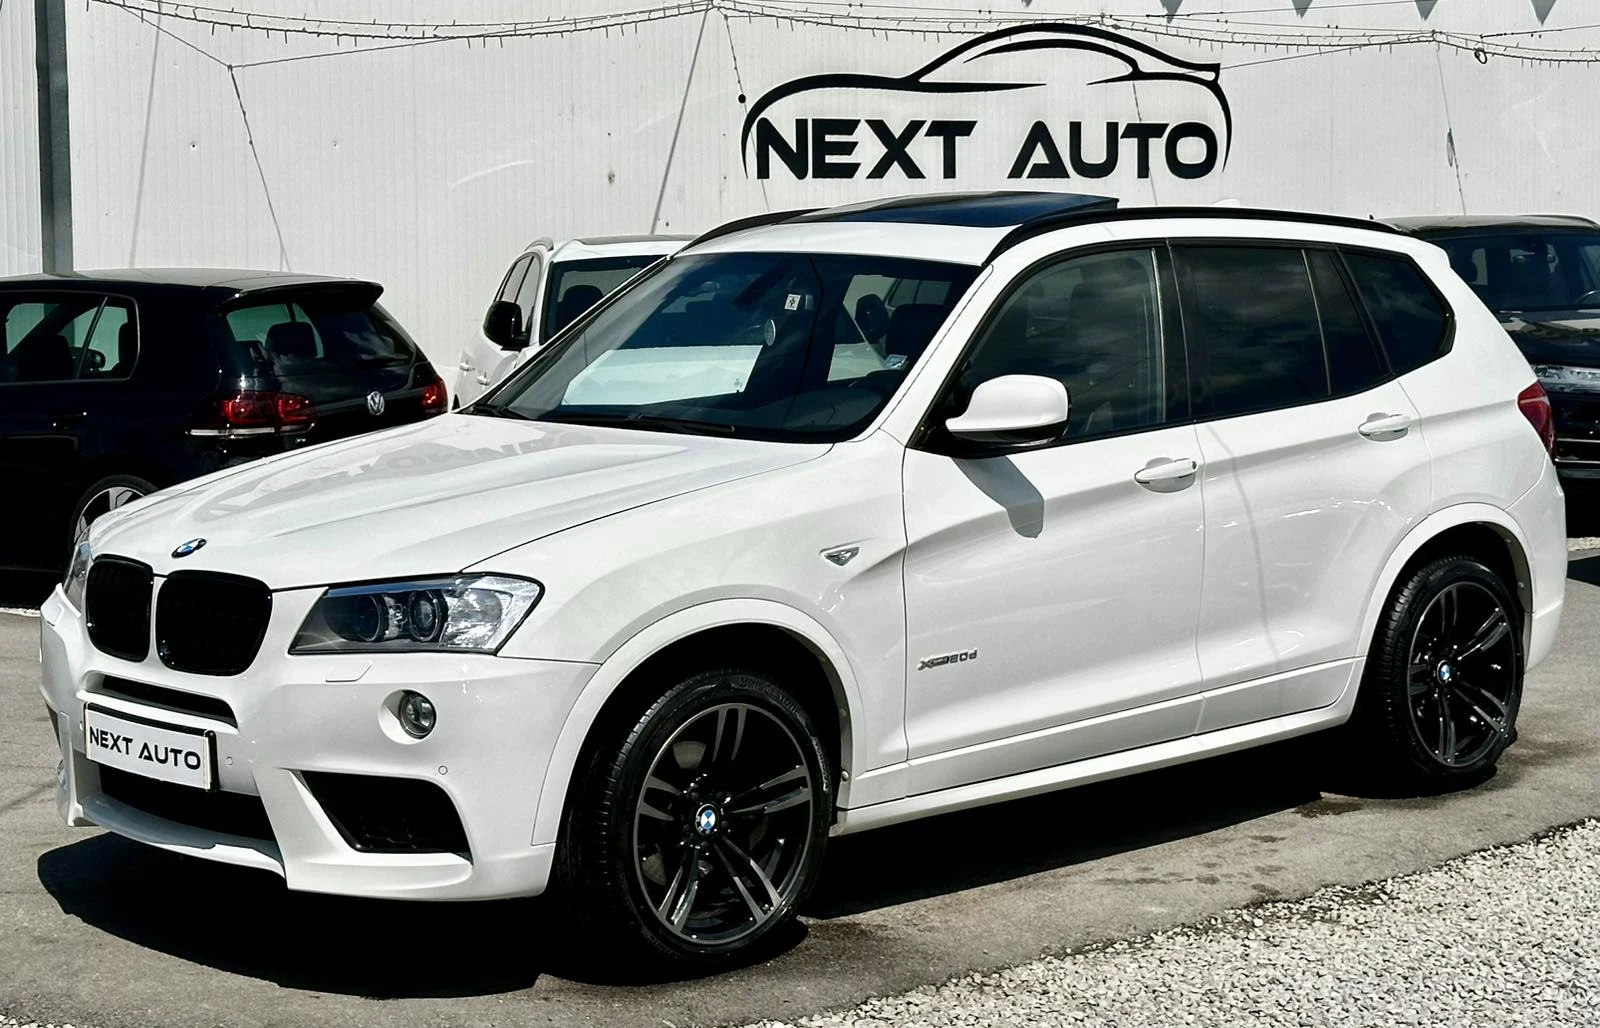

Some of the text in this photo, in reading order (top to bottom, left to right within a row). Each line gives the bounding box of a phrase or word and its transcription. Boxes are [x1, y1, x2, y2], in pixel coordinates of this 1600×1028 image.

[756, 117, 1218, 180] NEXT AUTO
[89, 726, 201, 770] NEXT AUTO
